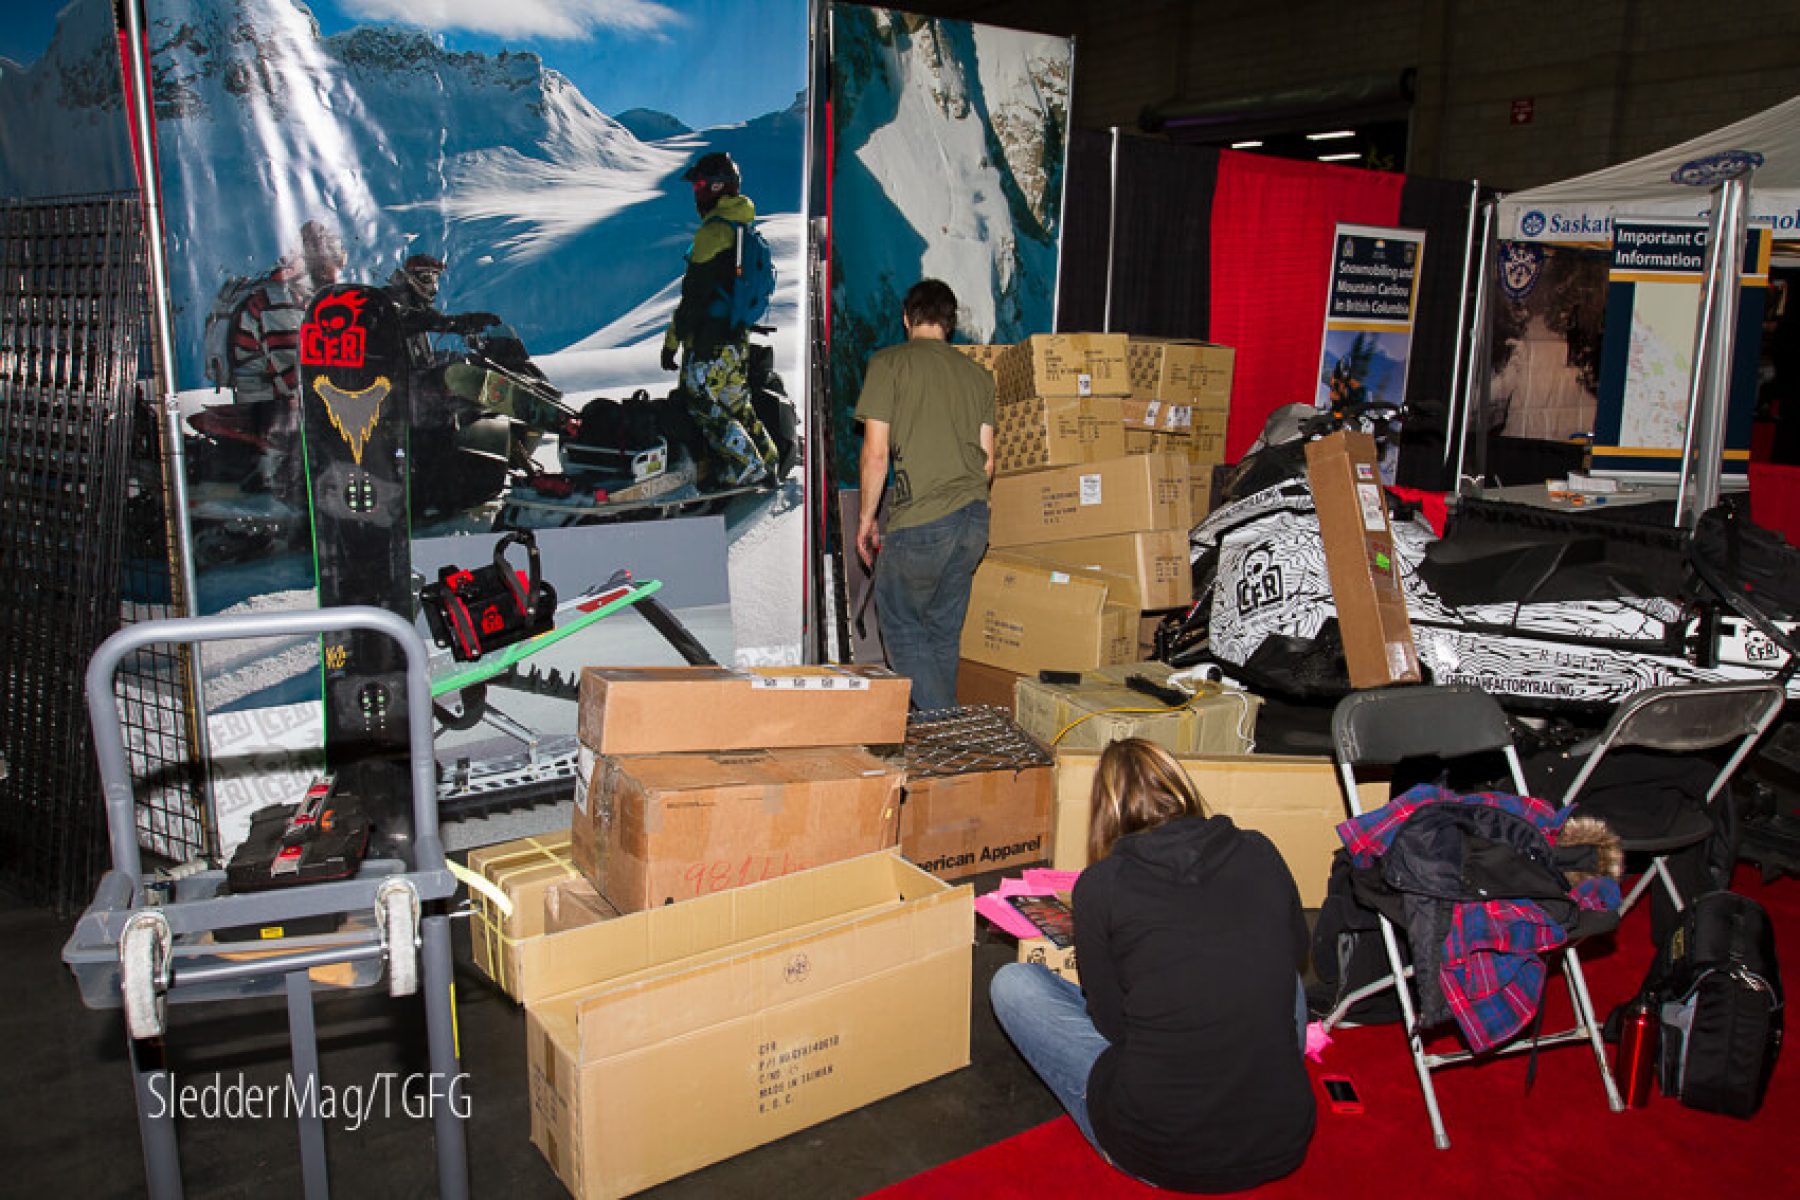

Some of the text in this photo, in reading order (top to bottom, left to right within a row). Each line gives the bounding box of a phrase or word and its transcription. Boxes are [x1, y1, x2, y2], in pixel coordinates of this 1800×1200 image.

[1616, 228, 1691, 246] Important
[1615, 249, 1701, 267] Information
[1339, 260, 1398, 281] Snowmobiling
[1335, 280, 1409, 297] Mountain Caribou
[1371, 300, 1409, 314] Columbia
[308, 331, 357, 364] CFR
[1239, 573, 1279, 612] CFR
[980, 834, 1041, 862] Apparel
